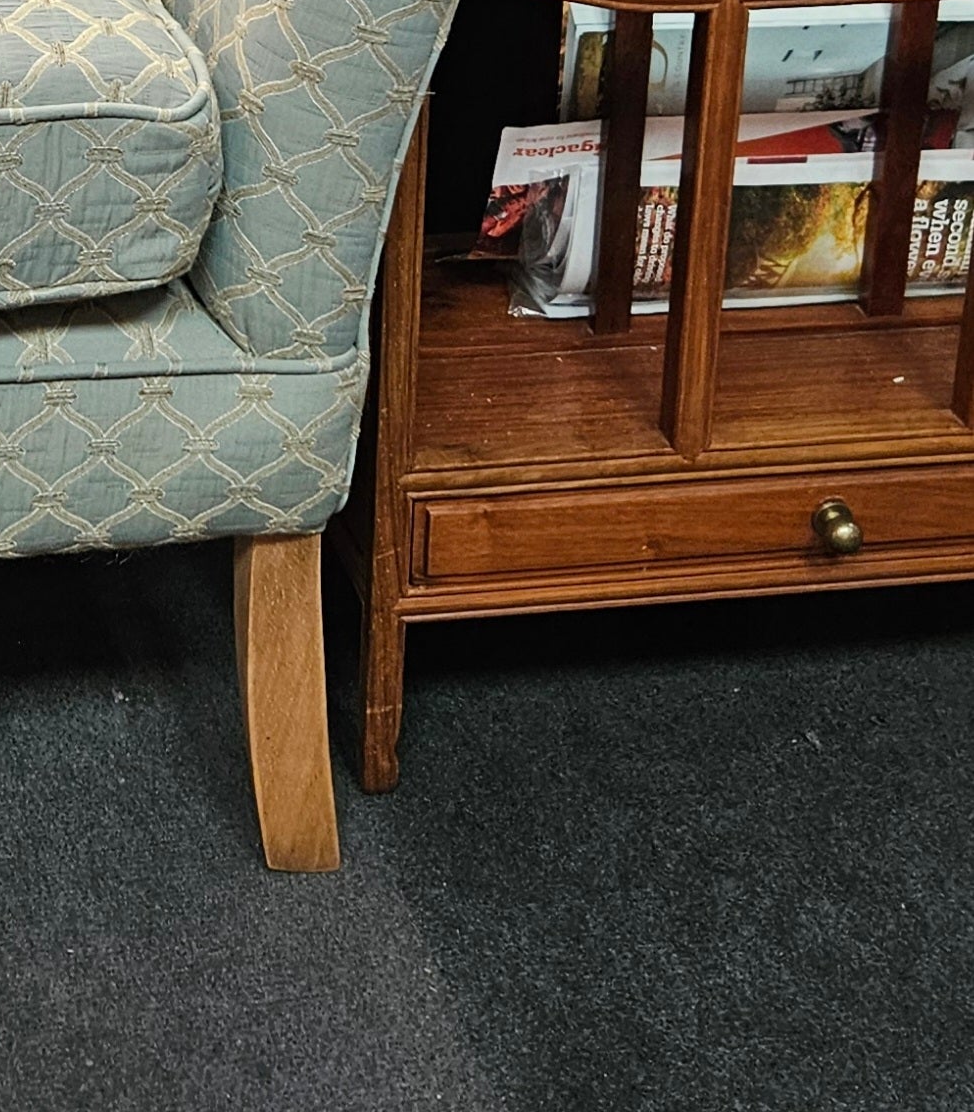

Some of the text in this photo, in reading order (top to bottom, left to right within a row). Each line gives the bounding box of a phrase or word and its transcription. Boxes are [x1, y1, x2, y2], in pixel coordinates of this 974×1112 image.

[513, 140, 603, 158] igaclear
[913, 198, 929, 212] a
[925, 199, 950, 257] when
[943, 199, 968, 268] second
[663, 231, 673, 244] do
[650, 244, 660, 254] to
